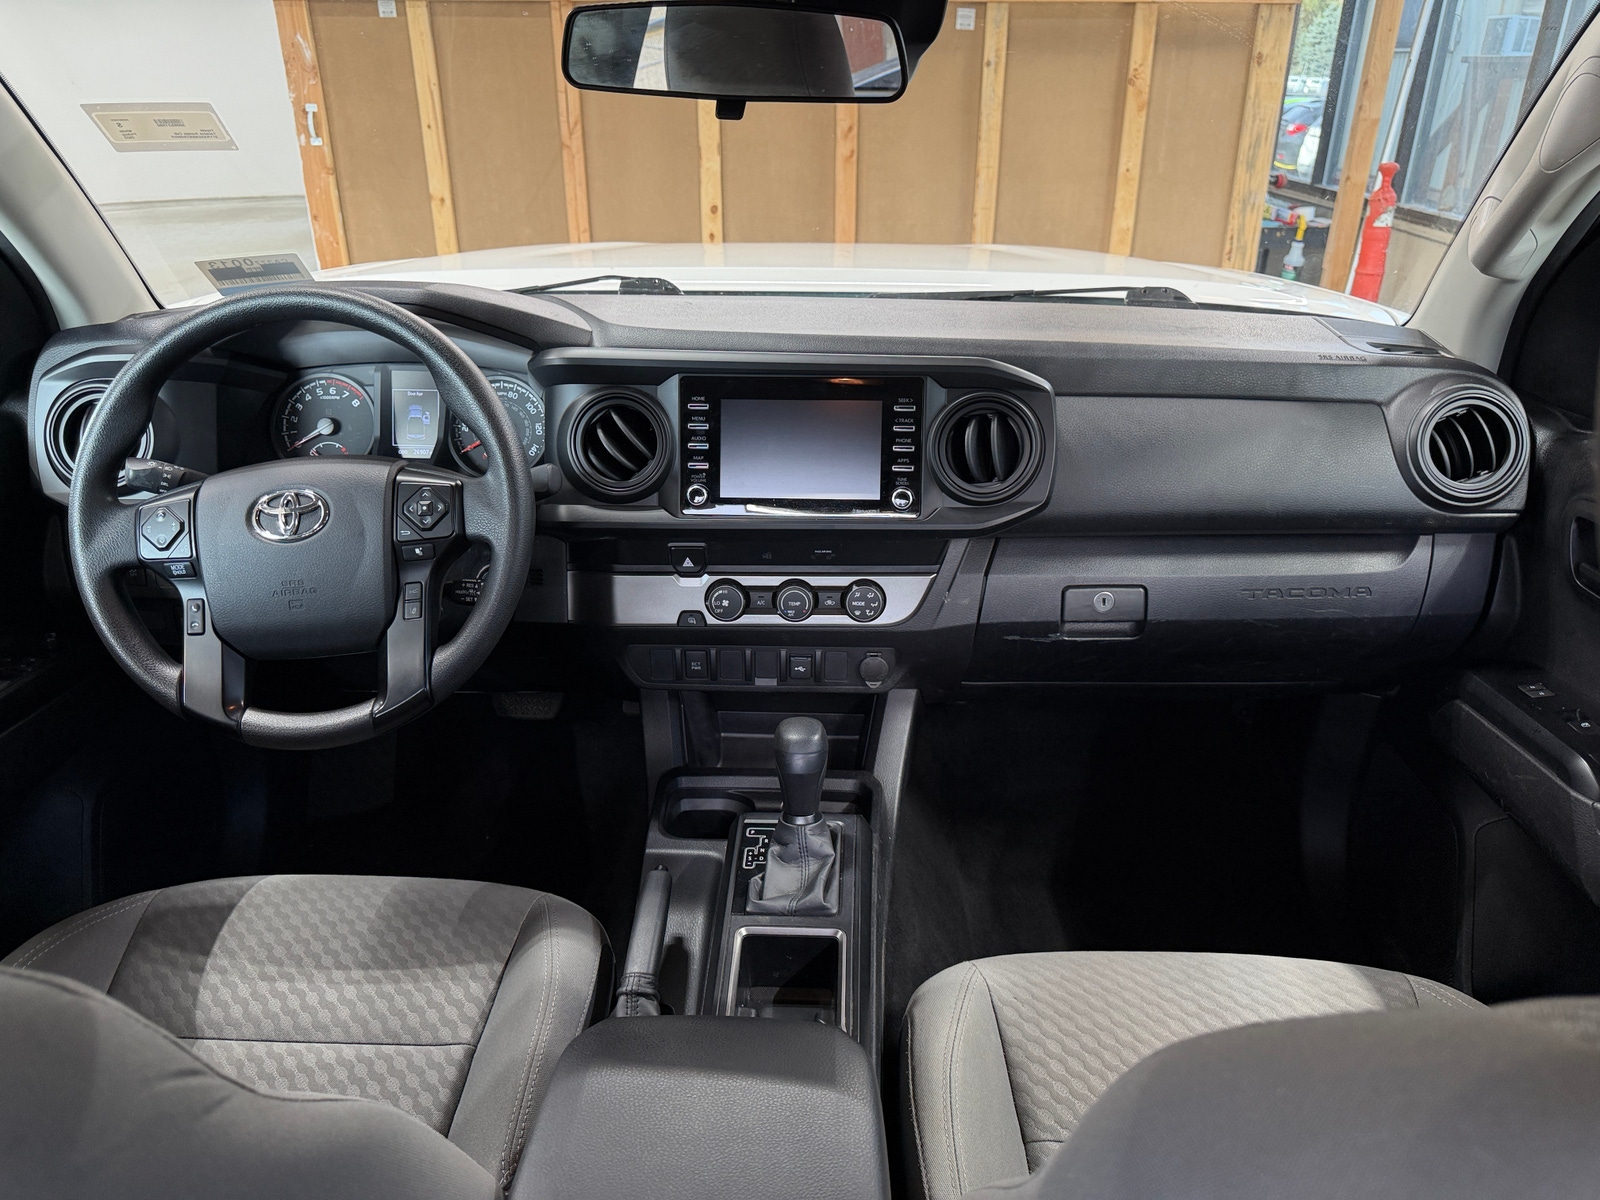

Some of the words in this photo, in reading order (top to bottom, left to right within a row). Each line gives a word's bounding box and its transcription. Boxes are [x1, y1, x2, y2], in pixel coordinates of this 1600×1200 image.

[316, 387, 323, 396] 5
[329, 387, 337, 395] 6
[507, 391, 519, 400] 80
[305, 393, 312, 401] 4
[295, 403, 303, 411] 3
[351, 399, 361, 408] 8
[525, 402, 537, 415] 100
[535, 422, 543, 436] 120
[528, 443, 540, 457] 140
[1241, 586, 1372, 599] TACOMA
